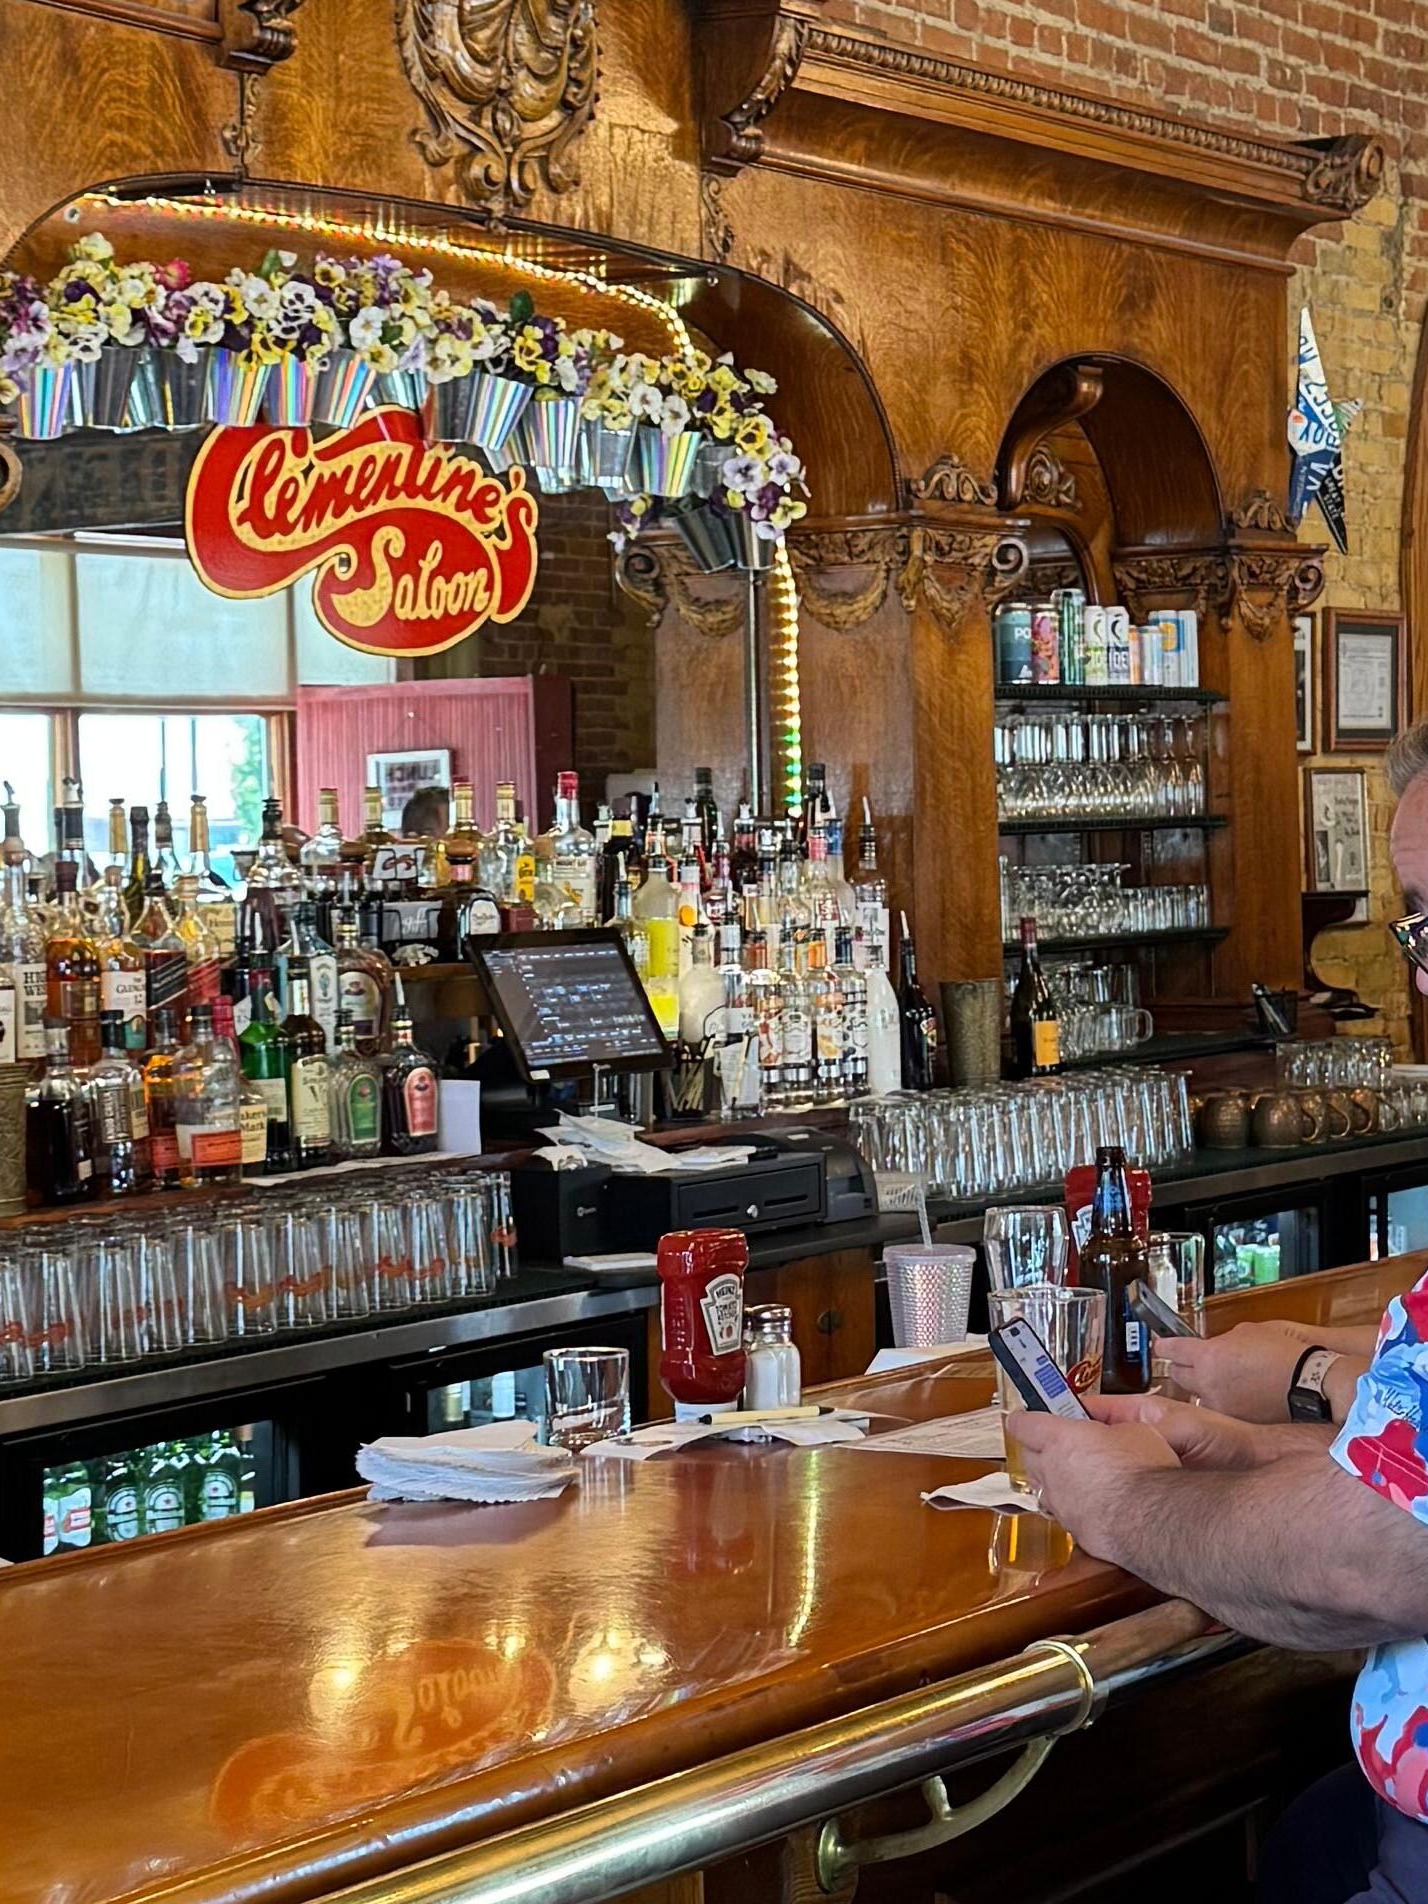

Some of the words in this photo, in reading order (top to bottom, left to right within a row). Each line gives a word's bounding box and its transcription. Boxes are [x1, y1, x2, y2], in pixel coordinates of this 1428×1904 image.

[186, 404, 538, 624] Clementine's
[328, 526, 493, 628] Saloon
[1014, 628, 1031, 640] PO
[715, 1285, 736, 1298] HEINZ
